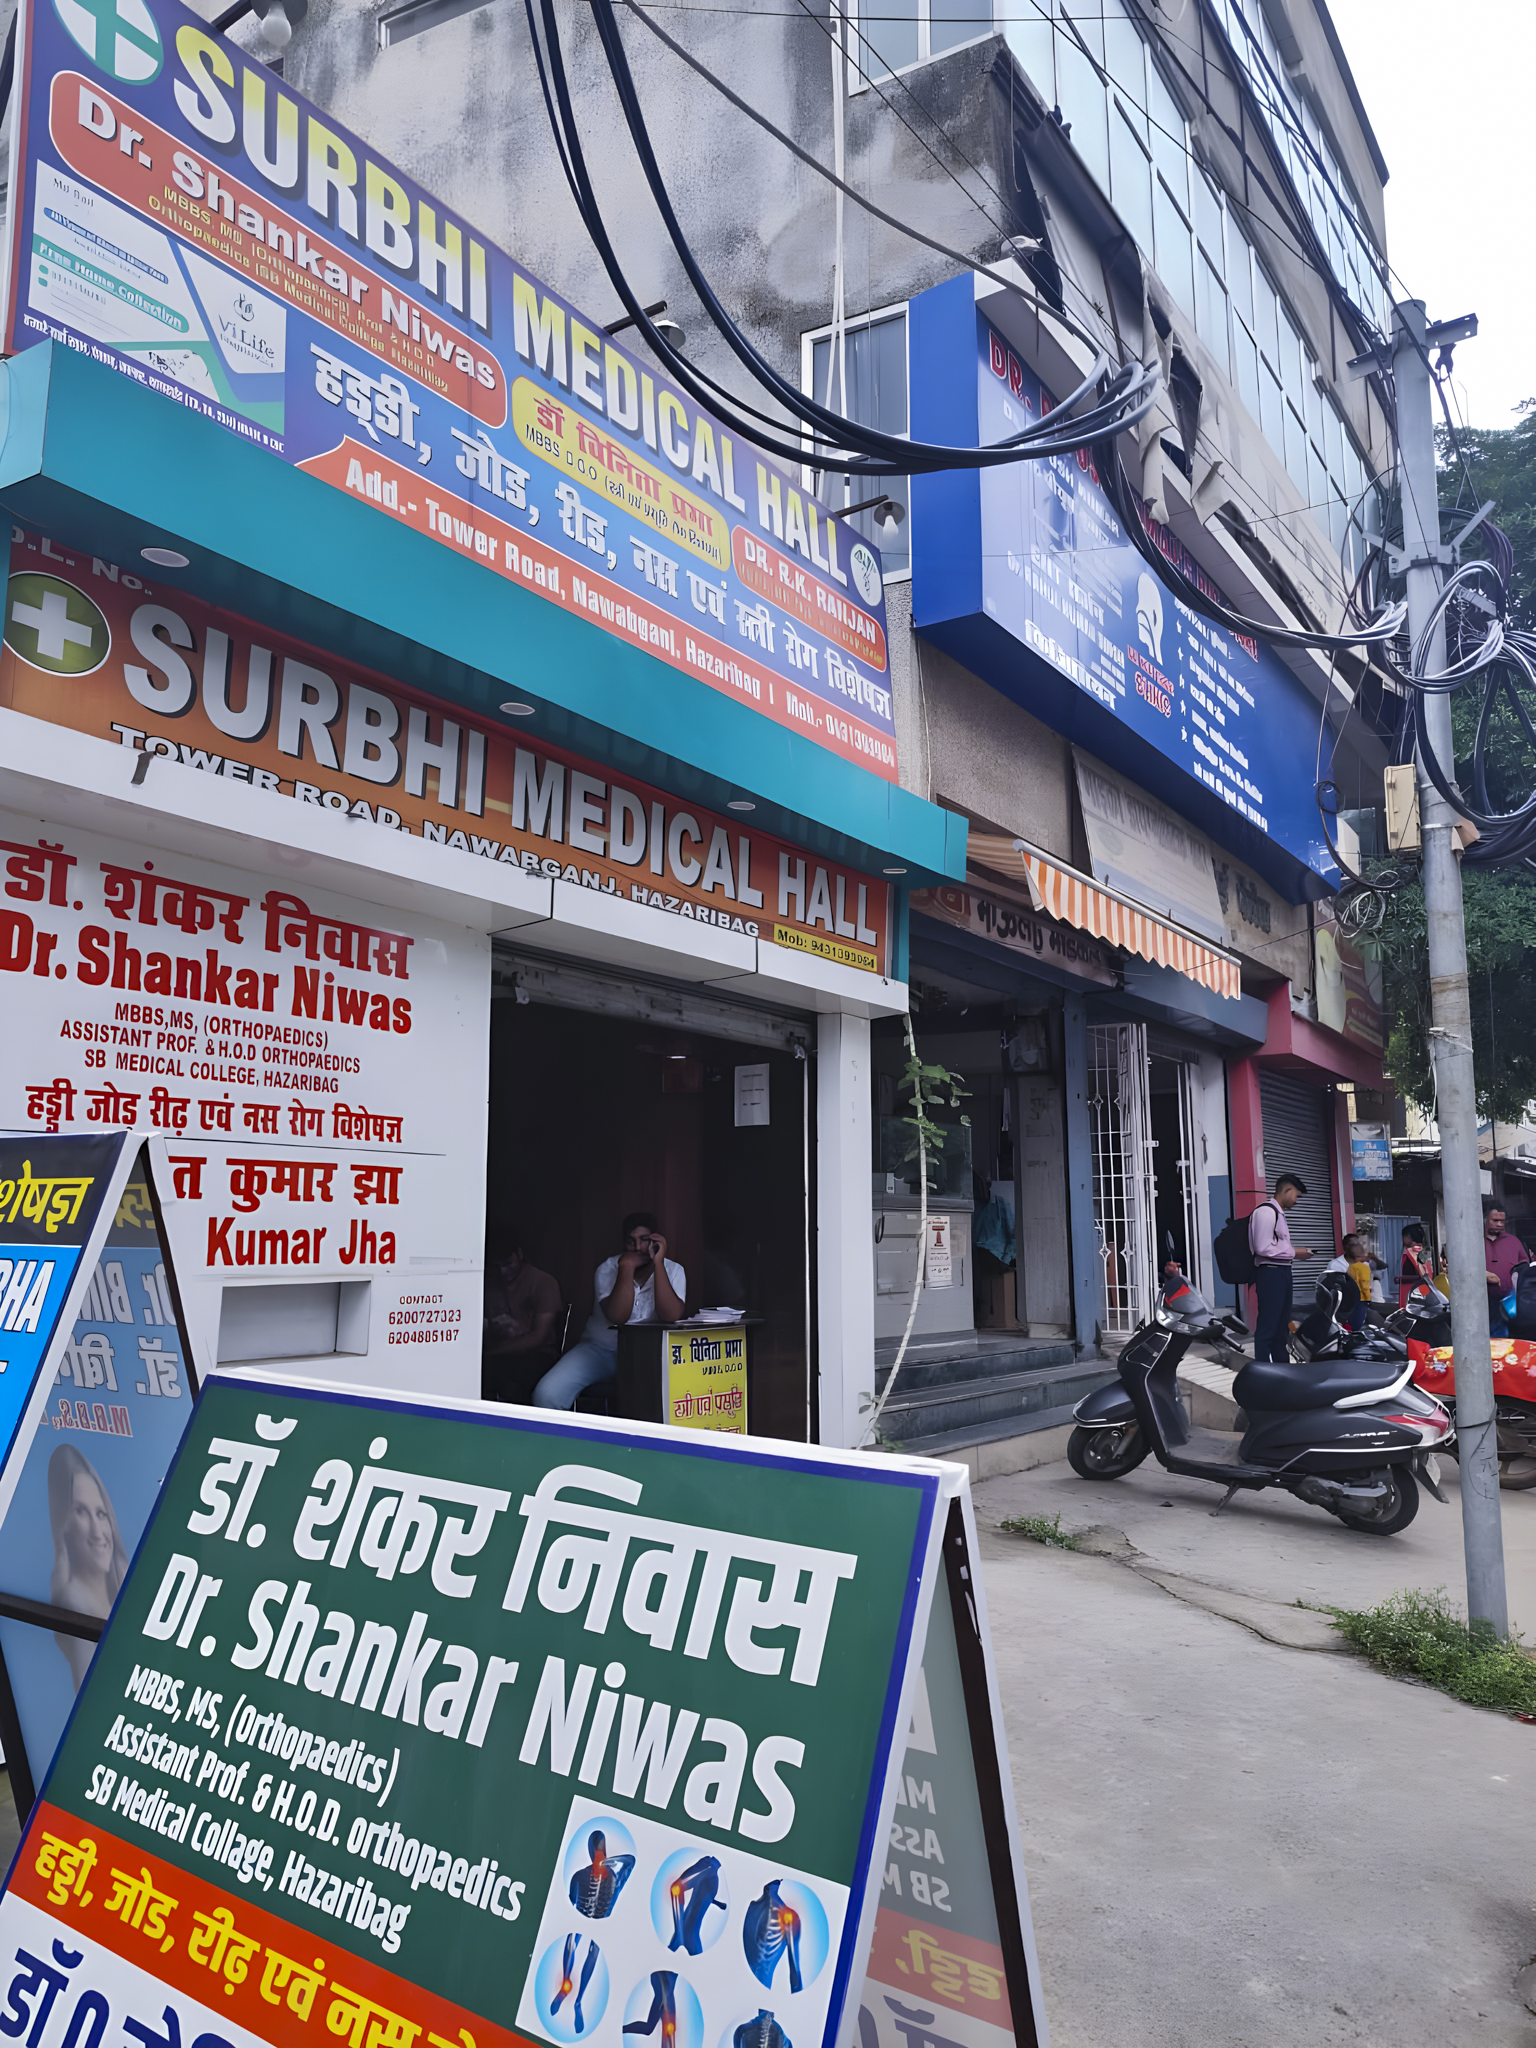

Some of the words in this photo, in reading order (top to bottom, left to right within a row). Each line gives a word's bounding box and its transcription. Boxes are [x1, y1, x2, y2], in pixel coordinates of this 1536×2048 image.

[78, 84, 152, 169] Dr.
[172, 151, 369, 305] Shankar
[381, 287, 496, 390] Niwas
[173, 25, 489, 331] SURBHI
[512, 271, 746, 513] MEDICAL
[756, 461, 848, 587] HALL
[425, 497, 498, 562] Tower
[505, 540, 566, 601] Road,
[744, 535, 774, 577] DR.
[110, 721, 282, 794] TOWER
[630, 883, 760, 938] HAZARIBAG
[123, 603, 489, 820] SURBHI
[511, 747, 765, 909] MEDICAL
[777, 850, 878, 948] HALL
[0, 838, 84, 911] डॉ.
[100, 860, 250, 944] शंकर
[260, 890, 414, 980] निवास
[0, 908, 67, 980] Dr.
[77, 924, 279, 1012] Shankar
[291, 965, 412, 1035] Niwas
[60, 1019, 152, 1048] ASSISTANT
[156, 1031, 197, 1054] PROF.
[205, 1038, 215, 1056] &
[262, 1046, 361, 1074] ORTHOPAEDICS
[84, 1048, 106, 1068] SB
[115, 1051, 185, 1077] MEDICAL
[190, 1061, 260, 1088] COLLEGE,
[263, 1070, 339, 1094] HAZARIBAG
[203, 1014, 329, 1052] (ORTHOPAEDICS)
[25, 1077, 78, 1133] हड्डी
[148, 1086, 191, 1137] रीढ़
[197, 1092, 235, 1132] एवं
[242, 1103, 281, 1135] नस
[287, 1097, 325, 1138] रोग
[206, 1216, 327, 1268] Kumar
[339, 1218, 396, 1267] Jha
[226, 1157, 338, 1213] कुमार
[350, 1163, 403, 1206] झा
[187, 1413, 299, 1548] डॉ.
[291, 1435, 513, 1599] शंकर
[501, 1463, 858, 1687] निवास
[124, 1664, 185, 1724] MBBS,
[184, 1686, 224, 1739] MS,
[223, 1693, 401, 1808] (Orthopaedics)
[141, 1552, 223, 1658] Dr.
[230, 1579, 520, 1749] Shankar
[518, 1654, 806, 1844] Niwas
[103, 1714, 199, 1784] Assistant
[195, 1749, 251, 1806] Prof.
[251, 1773, 274, 1813] &
[270, 1778, 341, 1847] H.O.D.
[84, 1763, 117, 1806] SB
[111, 1775, 197, 1845] Medical
[190, 1811, 276, 1893] Collage,
[278, 1849, 412, 1954] Hazaribag
[34, 1831, 99, 1908] हड्डी,
[187, 1906, 261, 1997] रीढ़
[259, 1957, 326, 2022] एवं
[325, 1982, 424, 2048] नस
